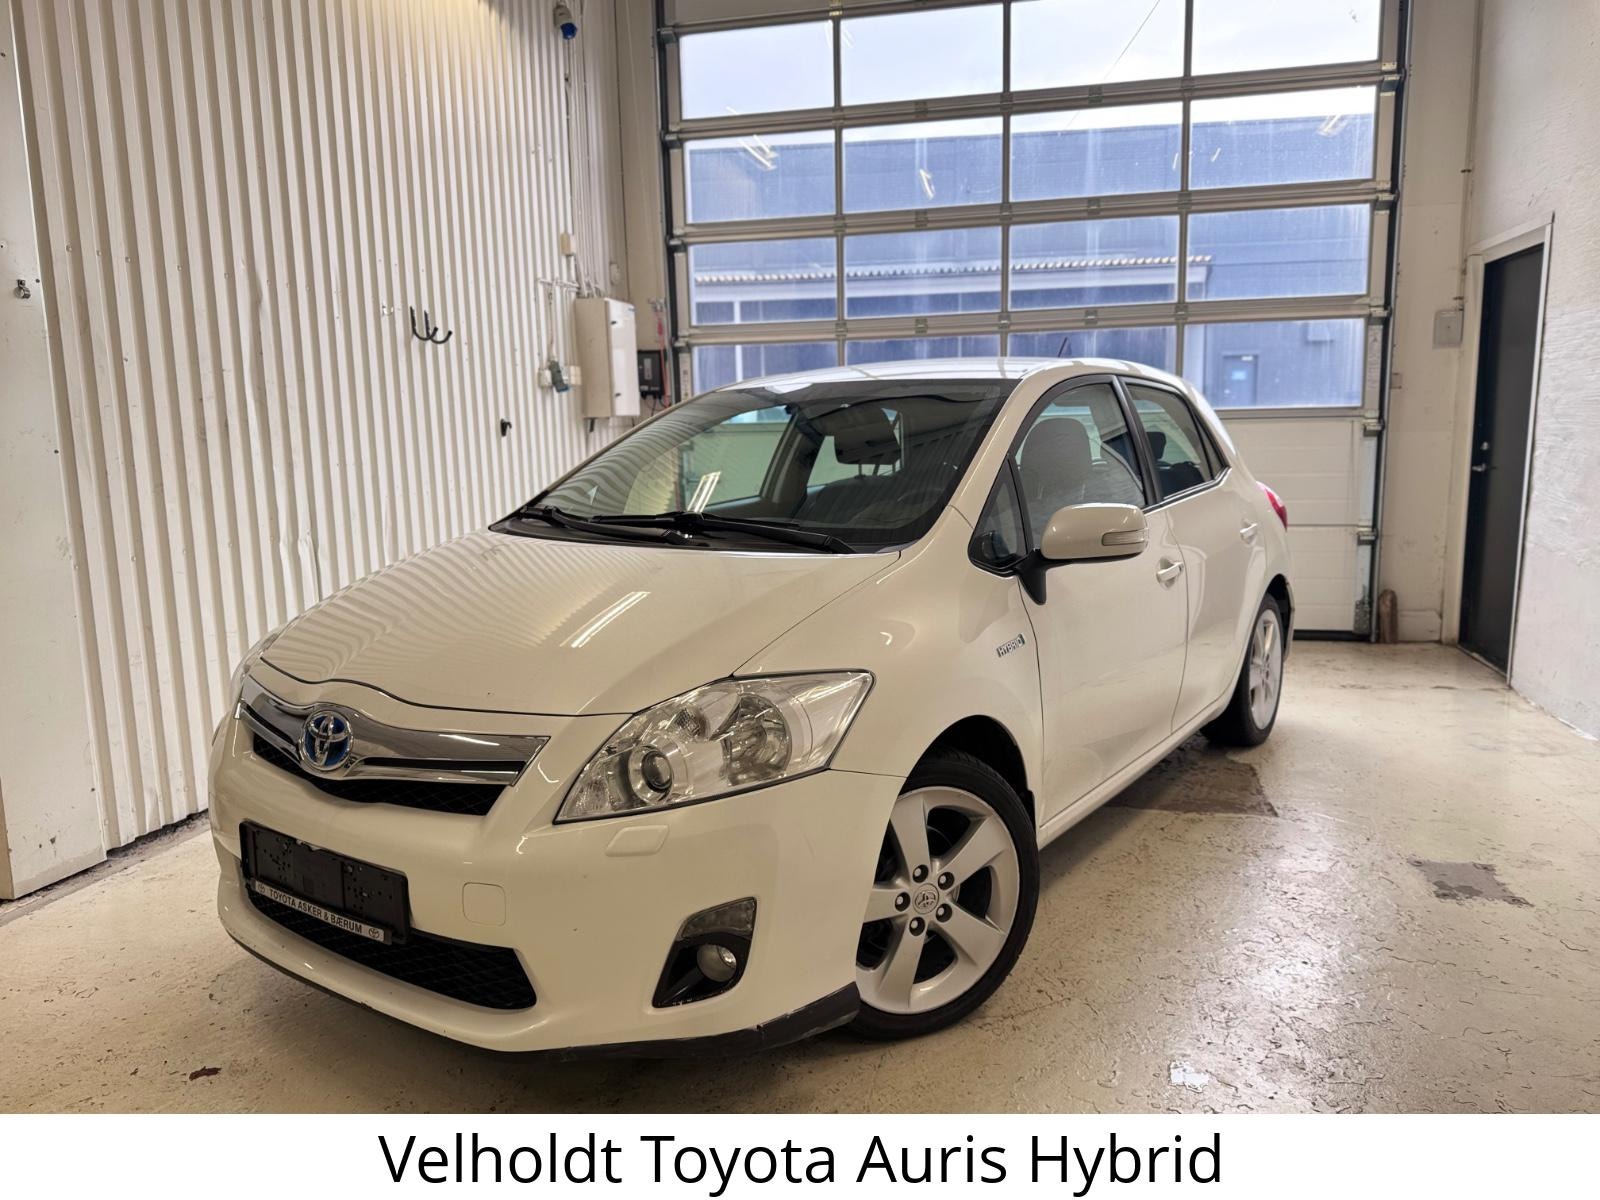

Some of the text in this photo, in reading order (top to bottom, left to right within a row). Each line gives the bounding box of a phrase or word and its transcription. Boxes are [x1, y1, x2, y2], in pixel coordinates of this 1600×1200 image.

[996, 635, 1024, 658] HYBRID
[269, 889, 362, 934] TOYOTA ASKER & BÆRUM
